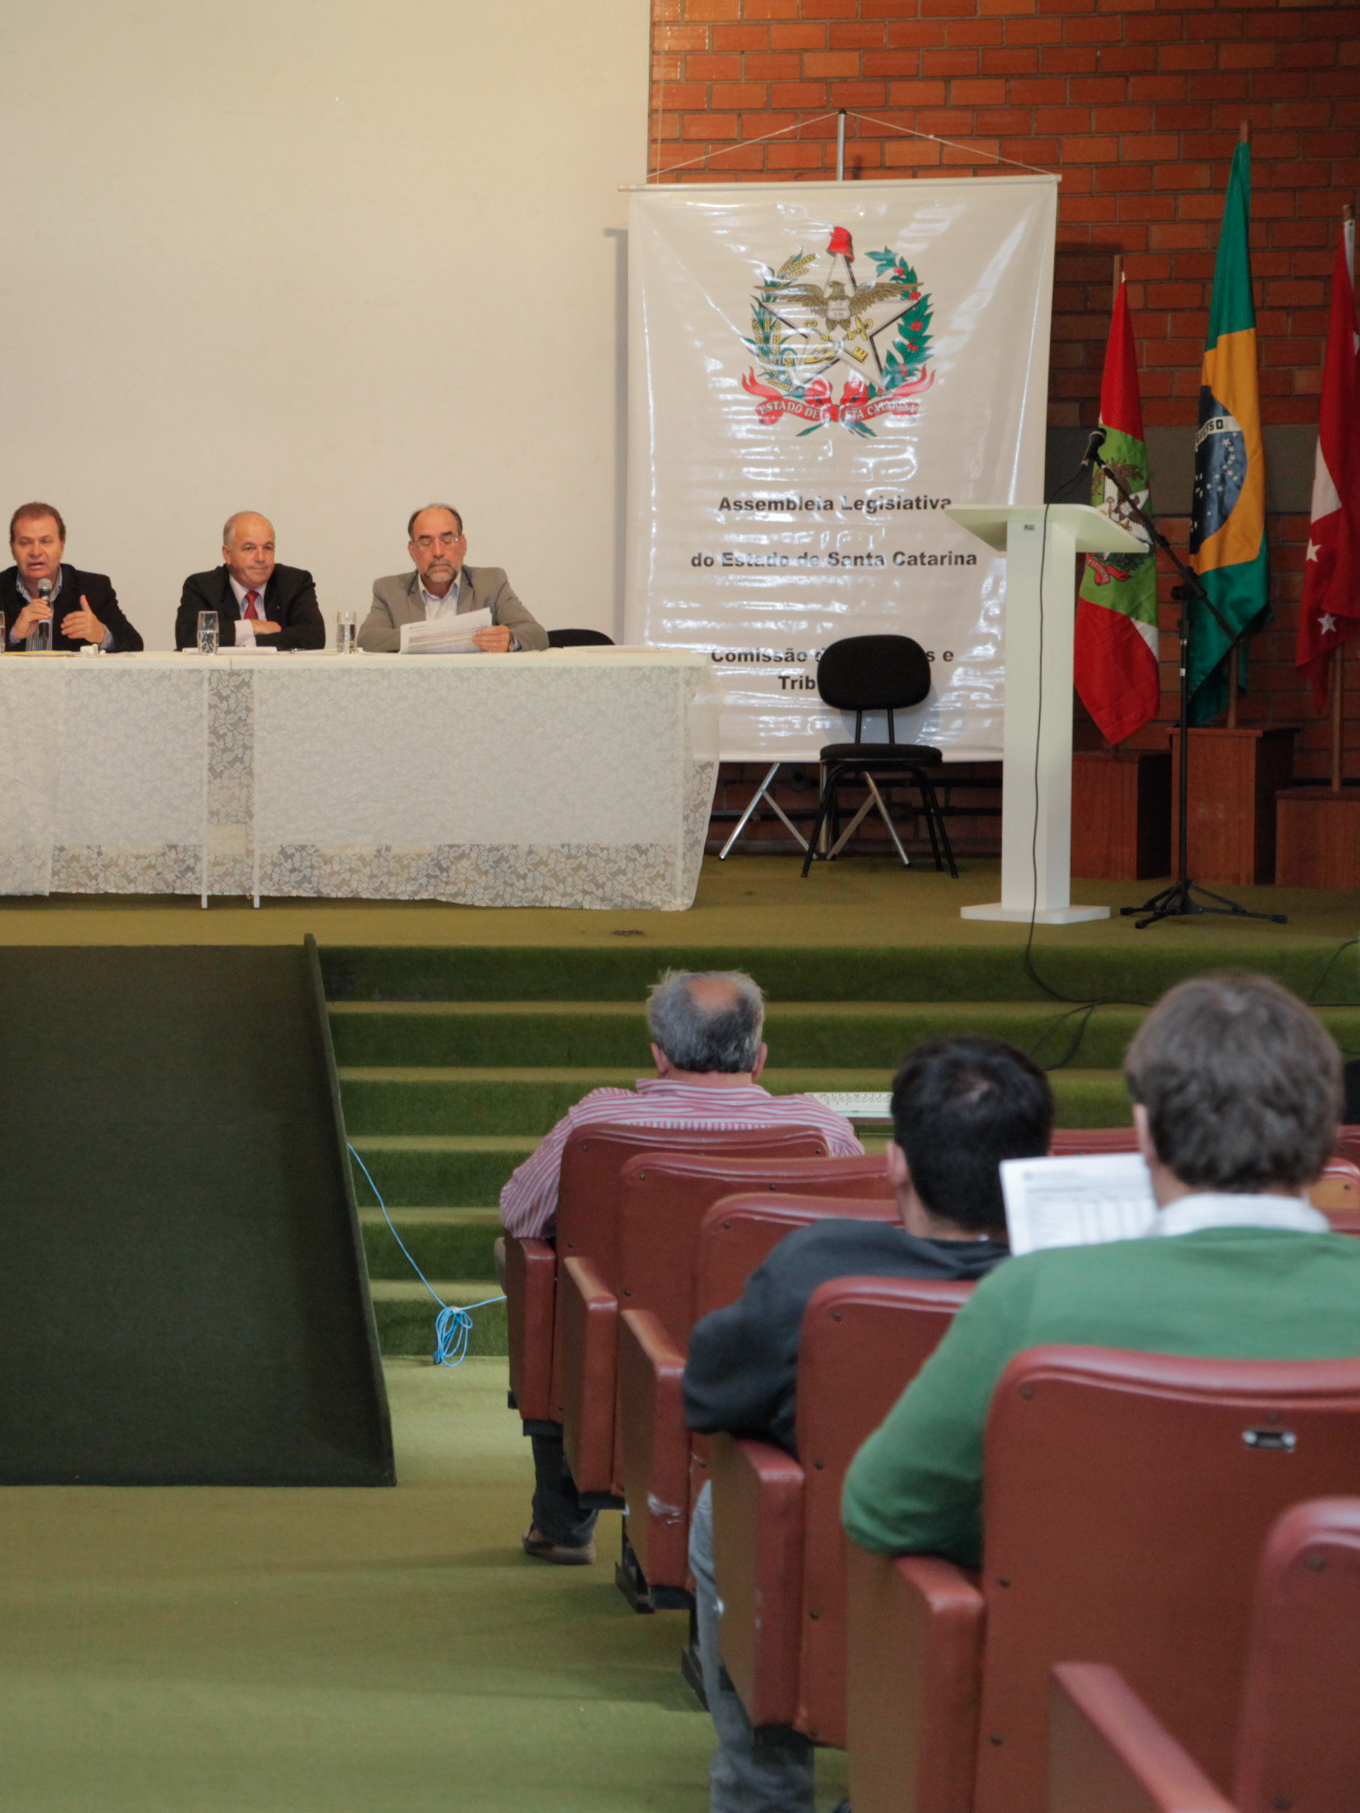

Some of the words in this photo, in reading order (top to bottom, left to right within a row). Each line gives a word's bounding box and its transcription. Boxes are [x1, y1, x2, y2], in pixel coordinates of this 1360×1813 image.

[719, 497, 834, 511] Assembleia
[691, 552, 714, 567] do
[722, 553, 789, 567] Estado
[797, 552, 819, 567] de
[828, 552, 885, 567] Santa
[892, 550, 978, 566] Catarina
[711, 648, 808, 662] Comissão
[943, 649, 954, 662] e
